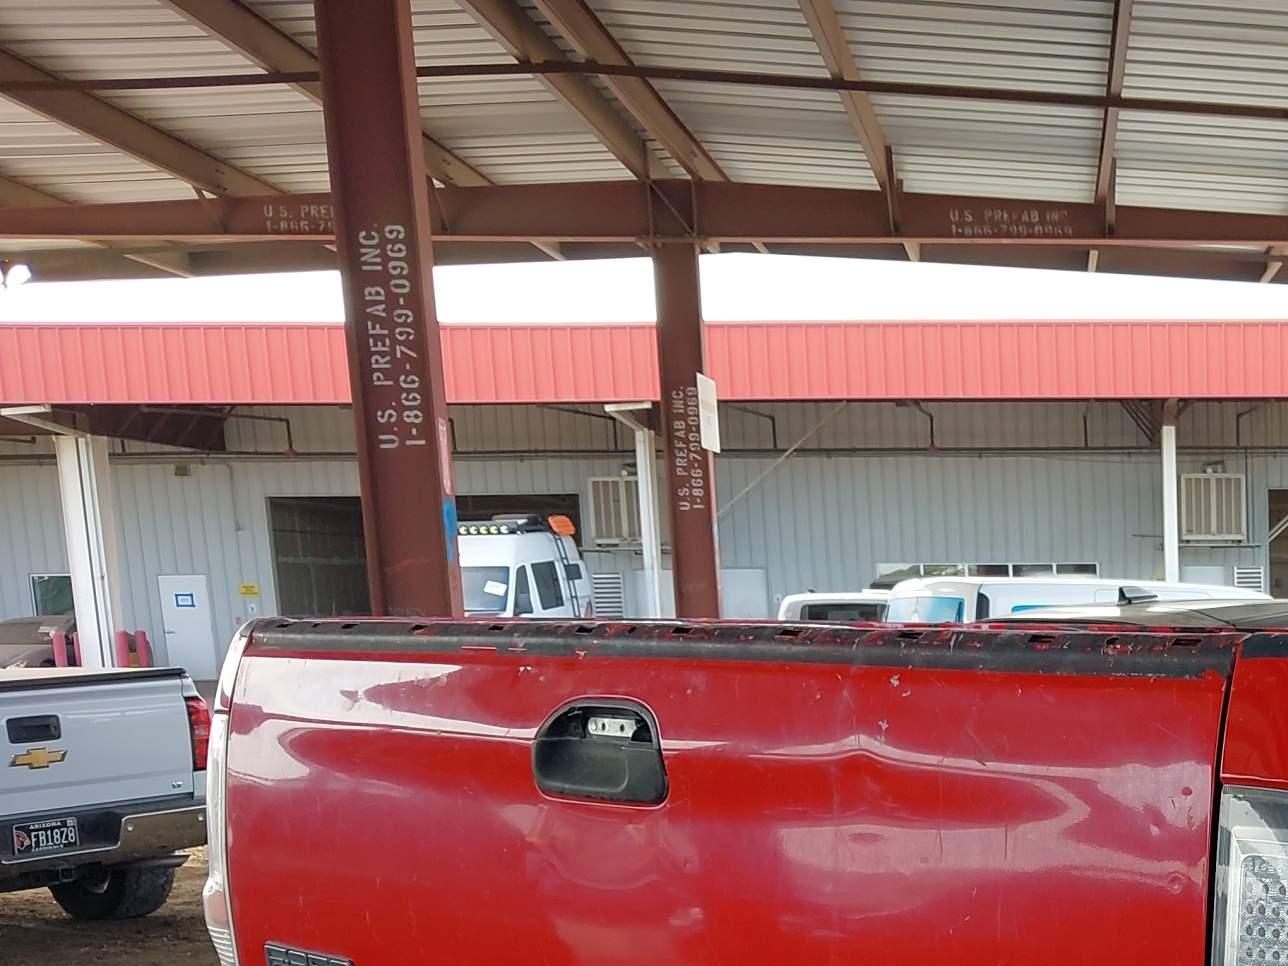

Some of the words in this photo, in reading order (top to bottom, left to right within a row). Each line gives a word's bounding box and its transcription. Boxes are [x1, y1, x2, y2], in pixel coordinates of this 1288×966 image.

[984, 208, 1040, 222] PREFAB
[358, 223, 383, 271] INC.
[364, 286, 394, 386] PREFAB
[384, 224, 426, 446] 1-866-799-0969
[671, 385, 685, 413] INC.
[376, 401, 399, 449] U.S.
[673, 420, 689, 476] PREFAB
[687, 386, 705, 510] 1-866-799-0969
[678, 483, 691, 511] U.S.
[29, 821, 62, 830] ARIZONA
